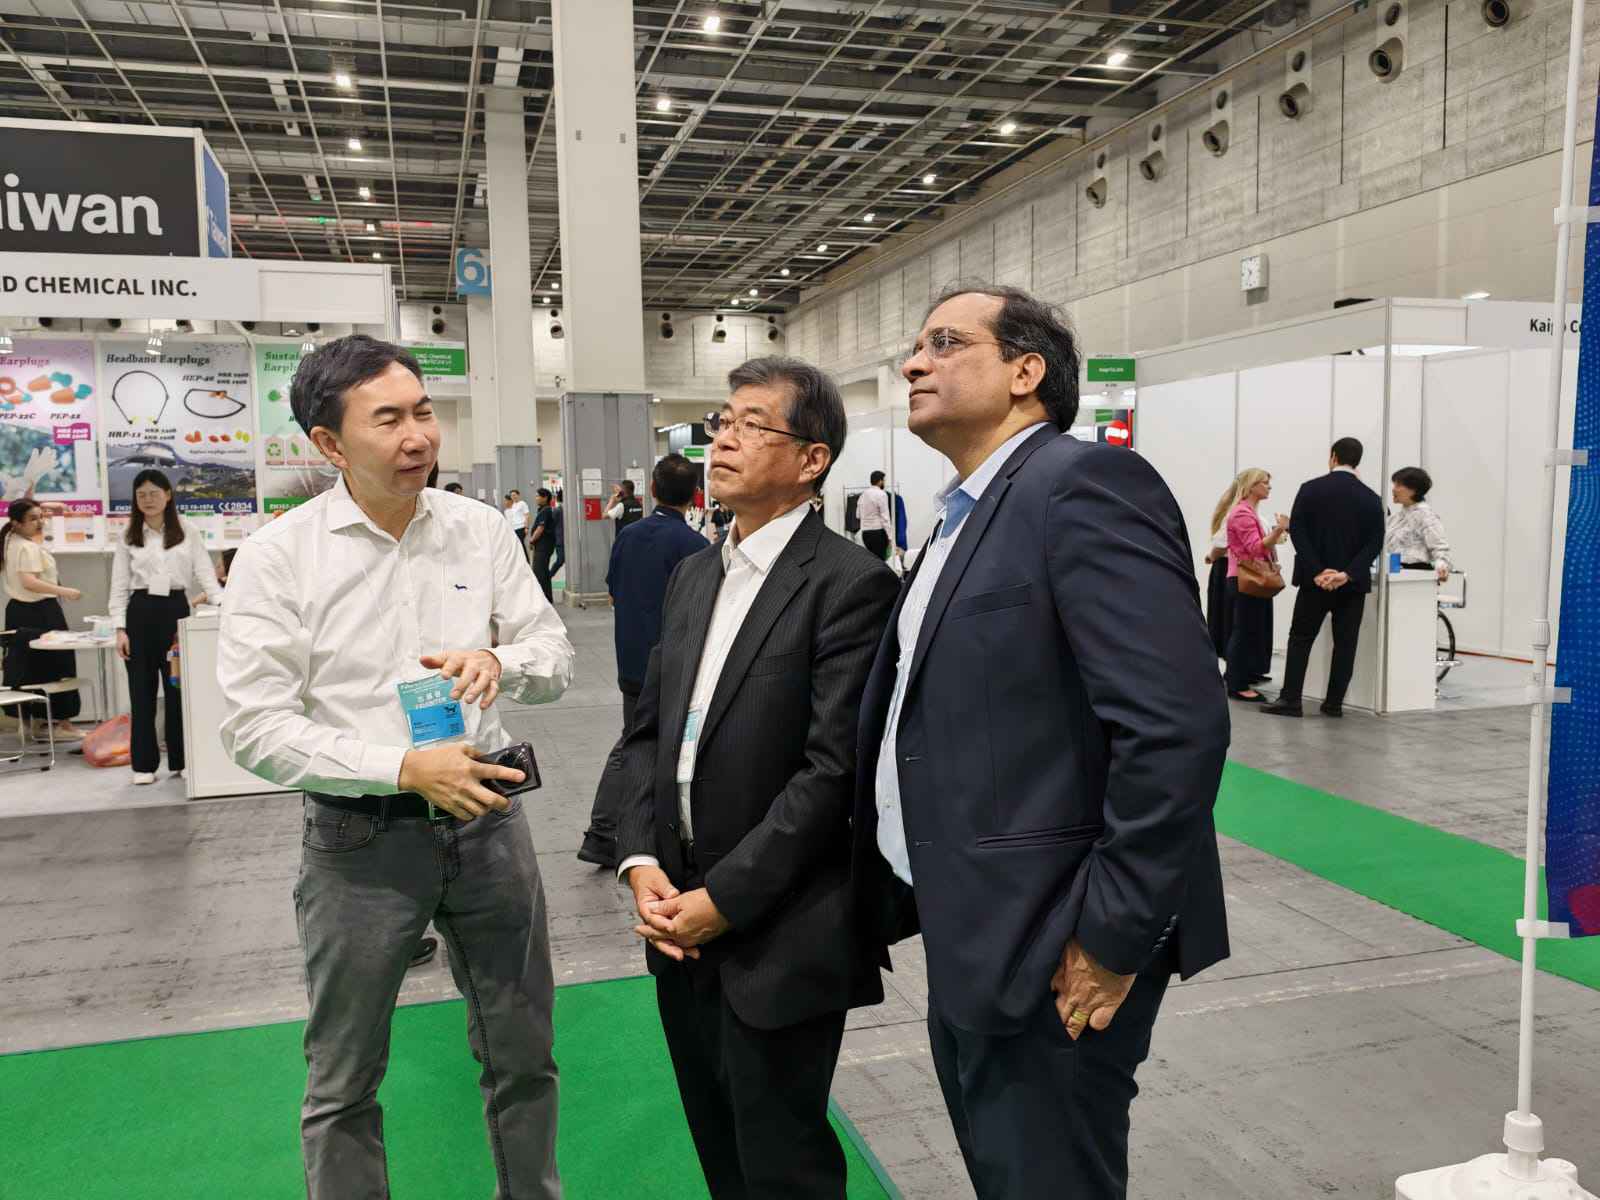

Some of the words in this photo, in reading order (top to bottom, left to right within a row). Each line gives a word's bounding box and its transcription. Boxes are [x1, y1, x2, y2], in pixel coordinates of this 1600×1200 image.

[0, 173, 163, 236] iwan
[0, 276, 18, 293] D
[25, 276, 145, 295] CHEMICAL
[152, 279, 197, 296] INC.
[106, 354, 157, 364] Headband
[159, 354, 210, 366] Earplugs
